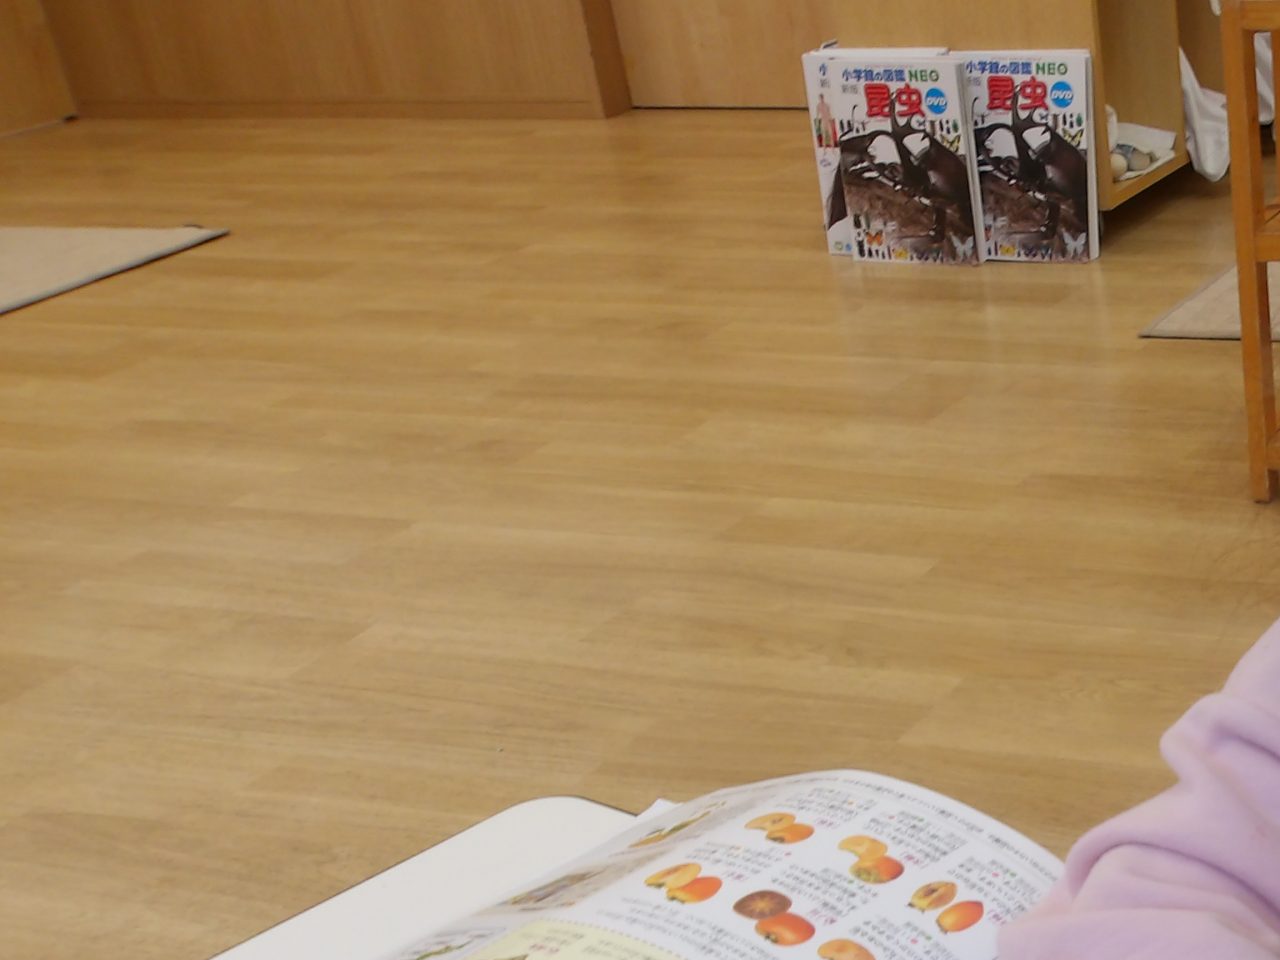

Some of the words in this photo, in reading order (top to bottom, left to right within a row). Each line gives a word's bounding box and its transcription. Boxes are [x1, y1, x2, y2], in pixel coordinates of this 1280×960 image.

[842, 69, 905, 82] 小学館の図鑑
[908, 70, 939, 82] NEO
[966, 61, 1032, 75] 小学館の図鑑
[1035, 62, 1068, 76] NEO
[986, 75, 1048, 111] 昆虫
[1051, 89, 1073, 99] DVD
[863, 82, 926, 119] 昆虫
[926, 97, 948, 107] DVD
